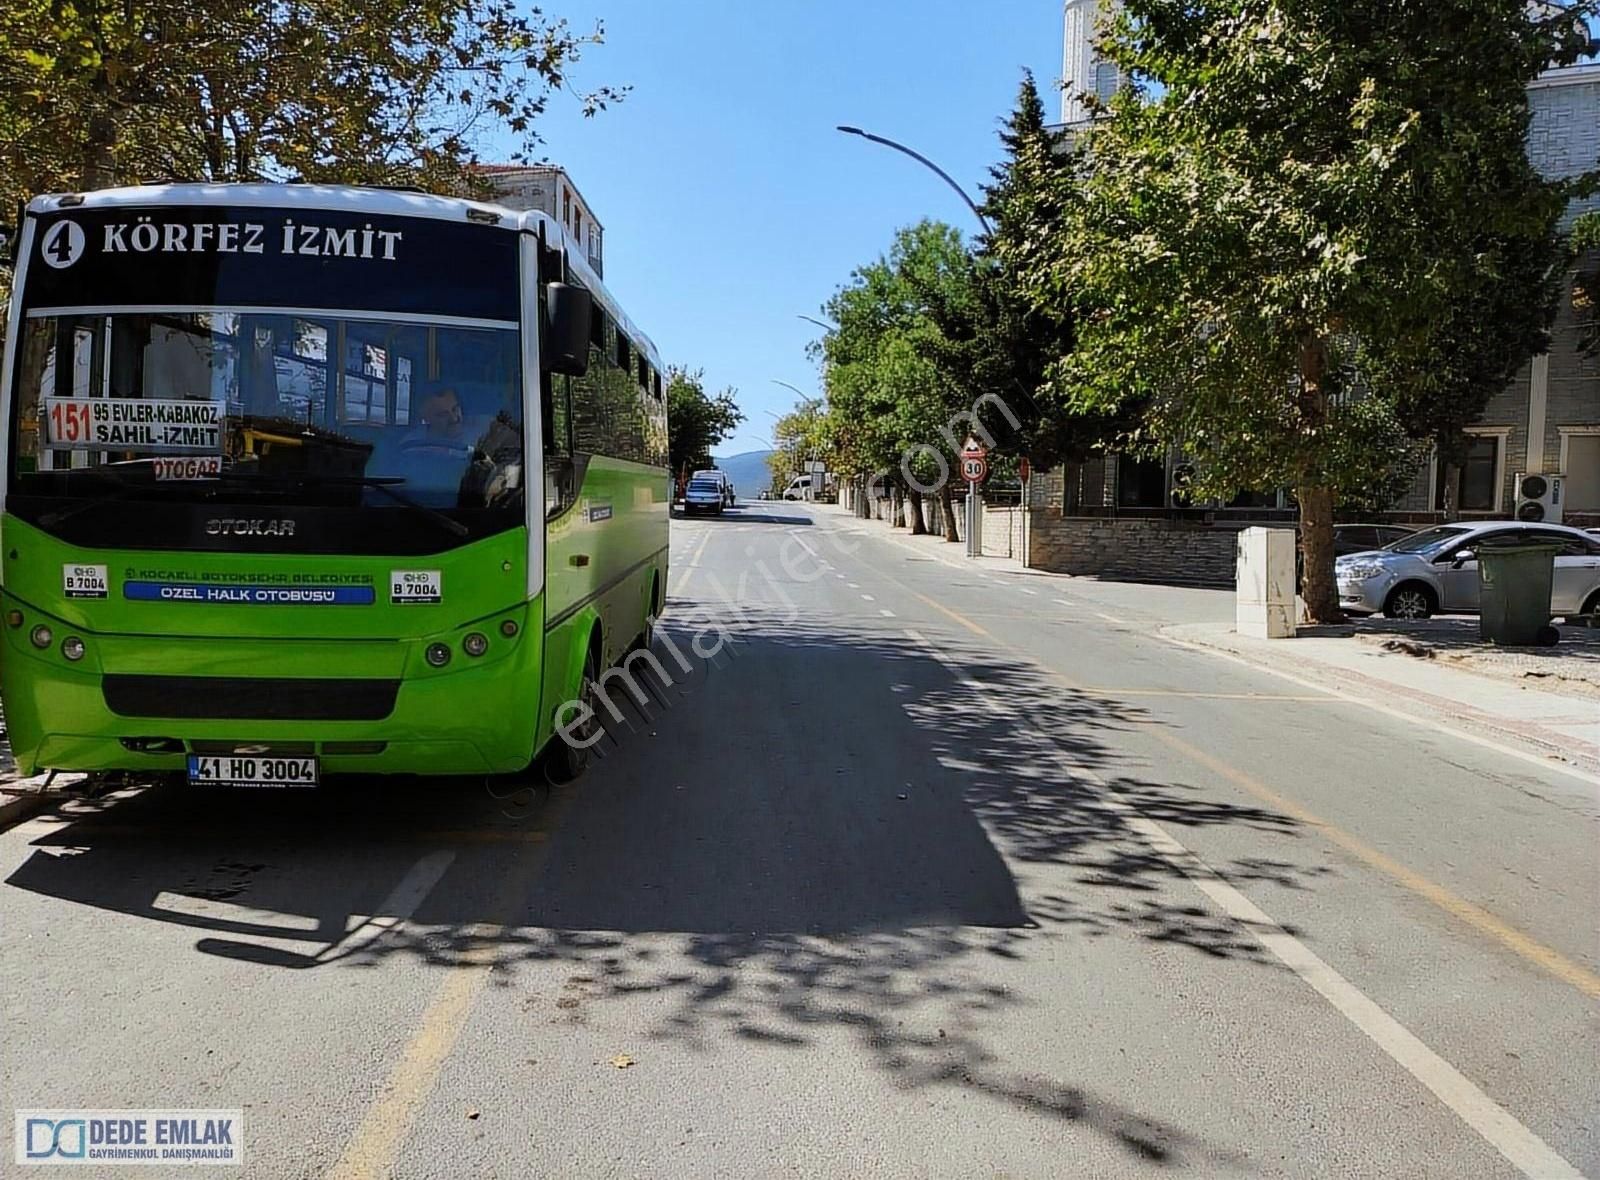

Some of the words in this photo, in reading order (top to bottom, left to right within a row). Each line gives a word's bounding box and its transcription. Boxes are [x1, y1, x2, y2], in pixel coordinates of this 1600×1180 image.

[47, 223, 72, 262] 4
[102, 216, 264, 253] KÖRFEZ
[281, 218, 402, 260] İZMİT
[94, 403, 109, 421] 95
[52, 403, 91, 441] 151
[153, 458, 218, 479] OTOGAR
[966, 463, 981, 474] 30
[207, 519, 296, 536] OTOKAR
[67, 577, 73, 588] B
[77, 577, 104, 589] 7004
[394, 584, 402, 595] B
[406, 584, 437, 595] 7004
[208, 589, 250, 600] HALK
[200, 759, 220, 779] 41
[262, 760, 313, 781] 3004
